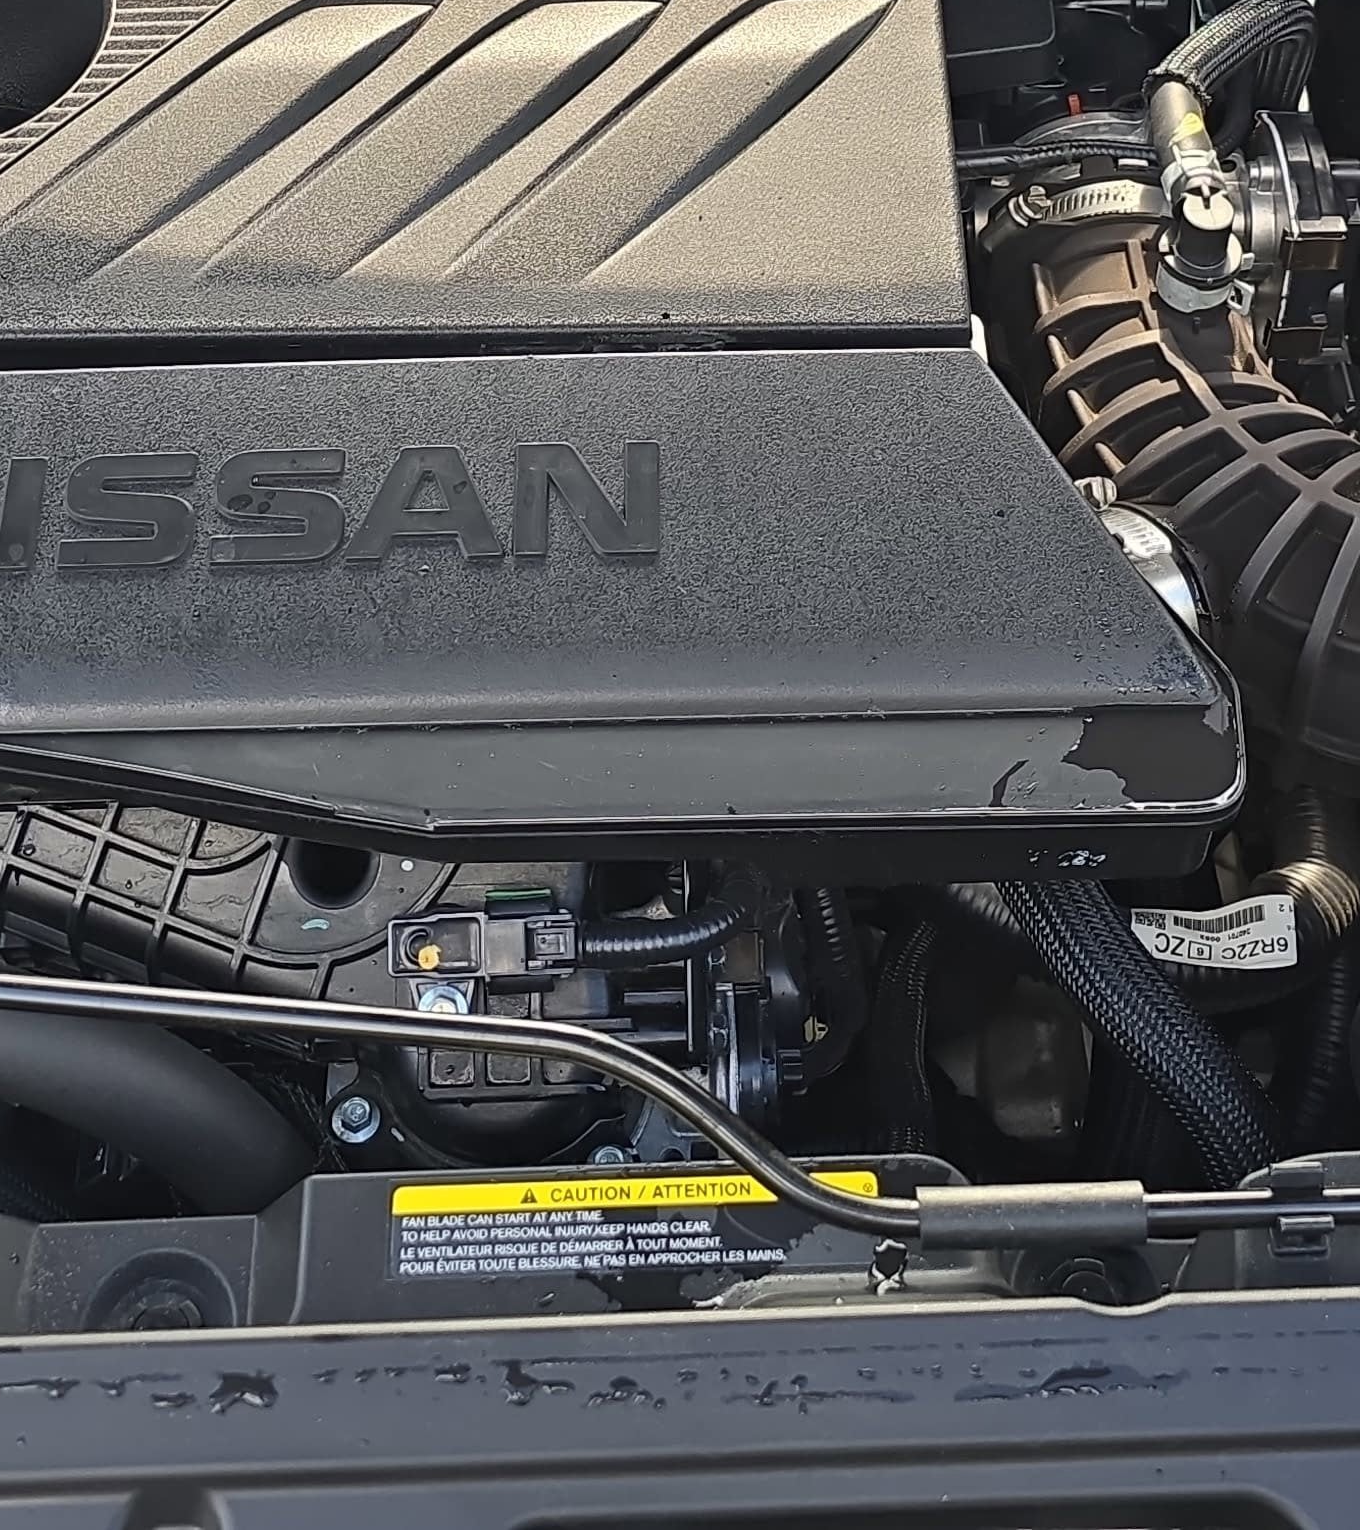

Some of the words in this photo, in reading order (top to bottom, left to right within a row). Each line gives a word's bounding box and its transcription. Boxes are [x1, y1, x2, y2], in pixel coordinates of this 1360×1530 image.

[1154, 932, 1186, 958] ZC
[1221, 937, 1289, 961] 6RZ2C
[550, 1186, 631, 1203] CAUTION
[652, 1181, 752, 1199] ATTENTION
[401, 1215, 425, 1228] FAN
[427, 1214, 465, 1227] BLADE
[467, 1213, 493, 1225] CAN
[495, 1212, 530, 1224] START
[533, 1211, 547, 1223] AT
[549, 1211, 574, 1223] ANY
[401, 1230, 418, 1243] TO
[420, 1229, 450, 1242] HELP
[451, 1228, 488, 1240] AVOID
[490, 1226, 552, 1238] PERSONAL
[626, 1221, 668, 1234] HANDS
[670, 1220, 712, 1232] CLEAR.
[400, 1246, 415, 1259] LE
[417, 1244, 492, 1258] VENTILATEUR
[494, 1242, 539, 1256] RISQUE
[541, 1241, 557, 1254] DE
[559, 1238, 625, 1253] DÉMARRER
[636, 1238, 667, 1250] TOUT
[669, 1236, 723, 1249] MOMENT.
[399, 1261, 435, 1274] POUR
[436, 1257, 476, 1272] ÉVITER
[478, 1258, 516, 1271] TOUTE
[602, 1253, 626, 1266] PAS
[628, 1253, 646, 1265] EN
[647, 1250, 721, 1264] APPROCHER
[723, 1249, 744, 1262] LES
[746, 1248, 788, 1261] MAINS.
